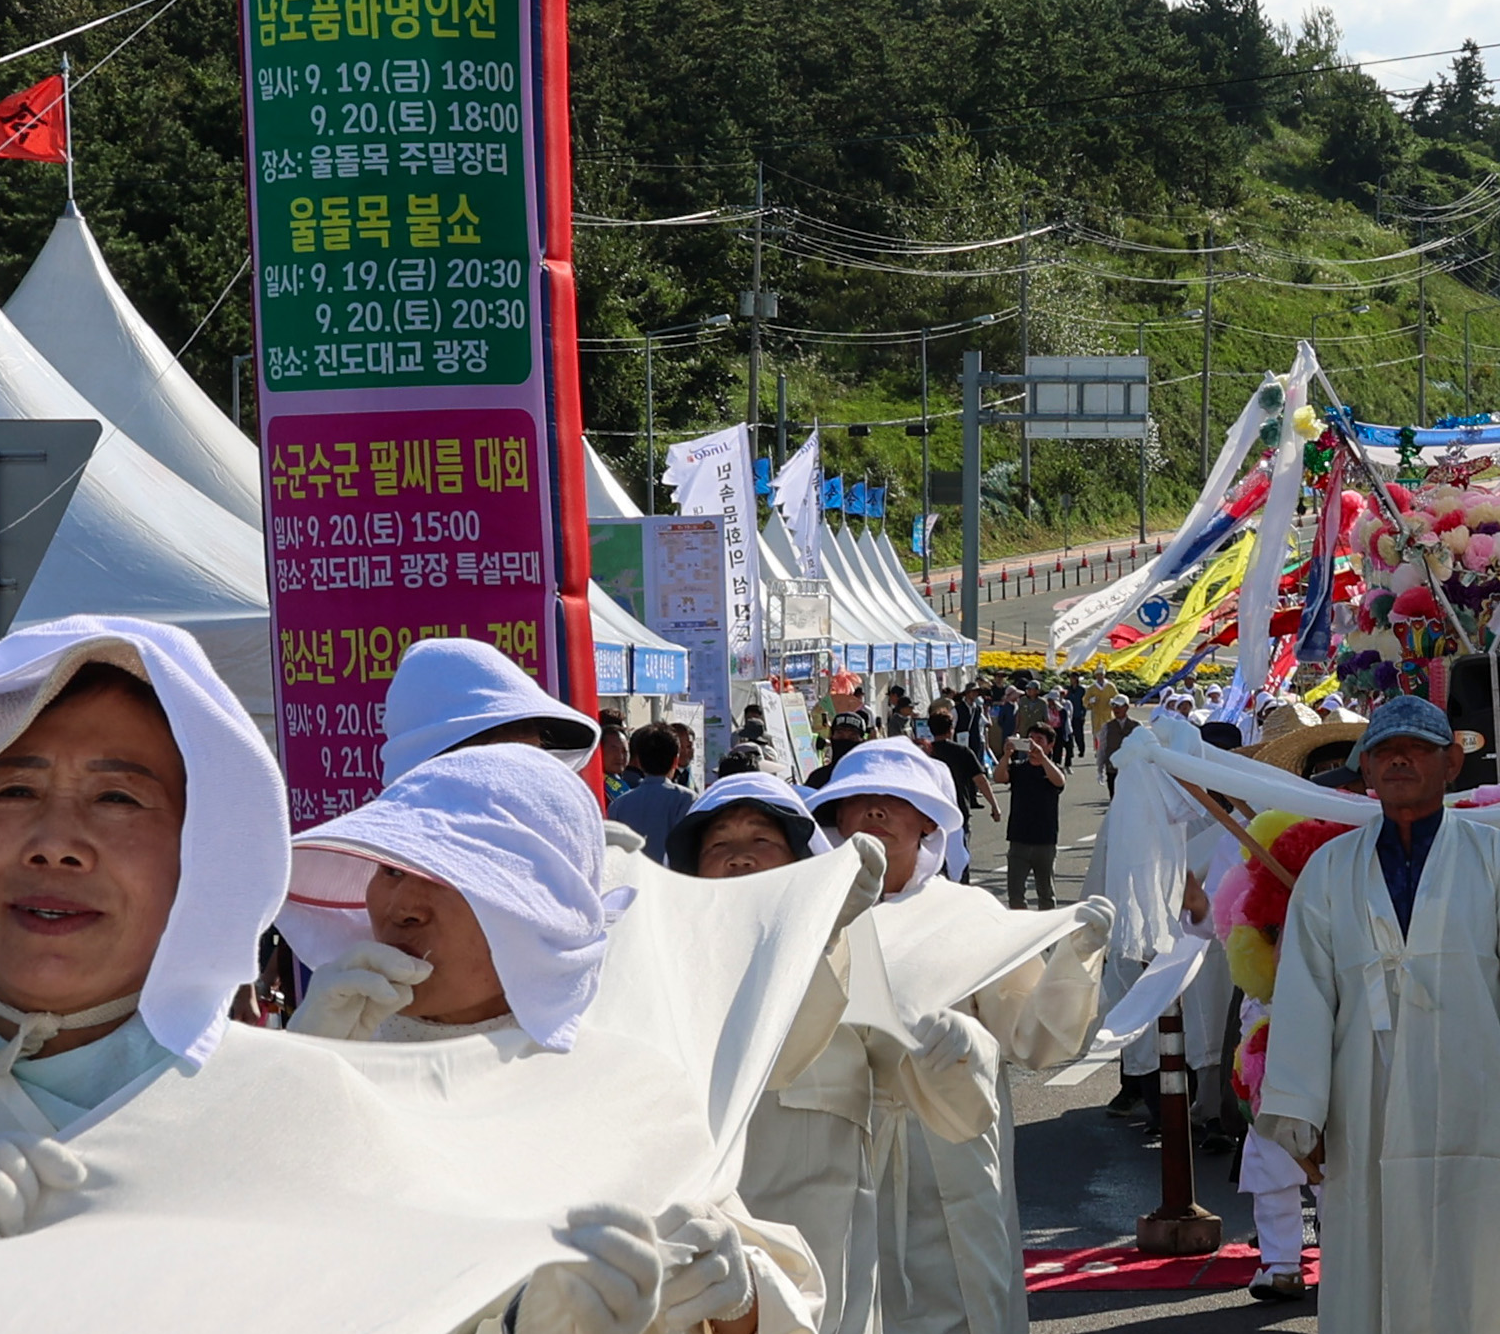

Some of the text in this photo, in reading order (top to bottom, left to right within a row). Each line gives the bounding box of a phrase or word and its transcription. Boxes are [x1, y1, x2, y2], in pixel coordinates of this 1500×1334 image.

[258, 65, 298, 100] 일시:
[441, 60, 514, 92] 18:00
[447, 102, 519, 133] 18:00
[261, 142, 508, 183] 장소: 울돌목 주말장터
[289, 193, 482, 252] 울돌목 불쇼
[265, 264, 304, 297] 일시:
[447, 259, 522, 290] 20:30
[451, 299, 526, 330] 20:30
[268, 339, 489, 380] 장소: 진도대교 광장
[271, 436, 530, 500] 수군수군 팔씨름 대회
[274, 515, 304, 550] 일시:
[412, 510, 480, 543] 15:00
[277, 551, 541, 593] 장소: 진도대교 광장 특설무대
[280, 627, 336, 685] 청소년
[286, 703, 313, 737] 일시:
[291, 788, 318, 822] 장소:
